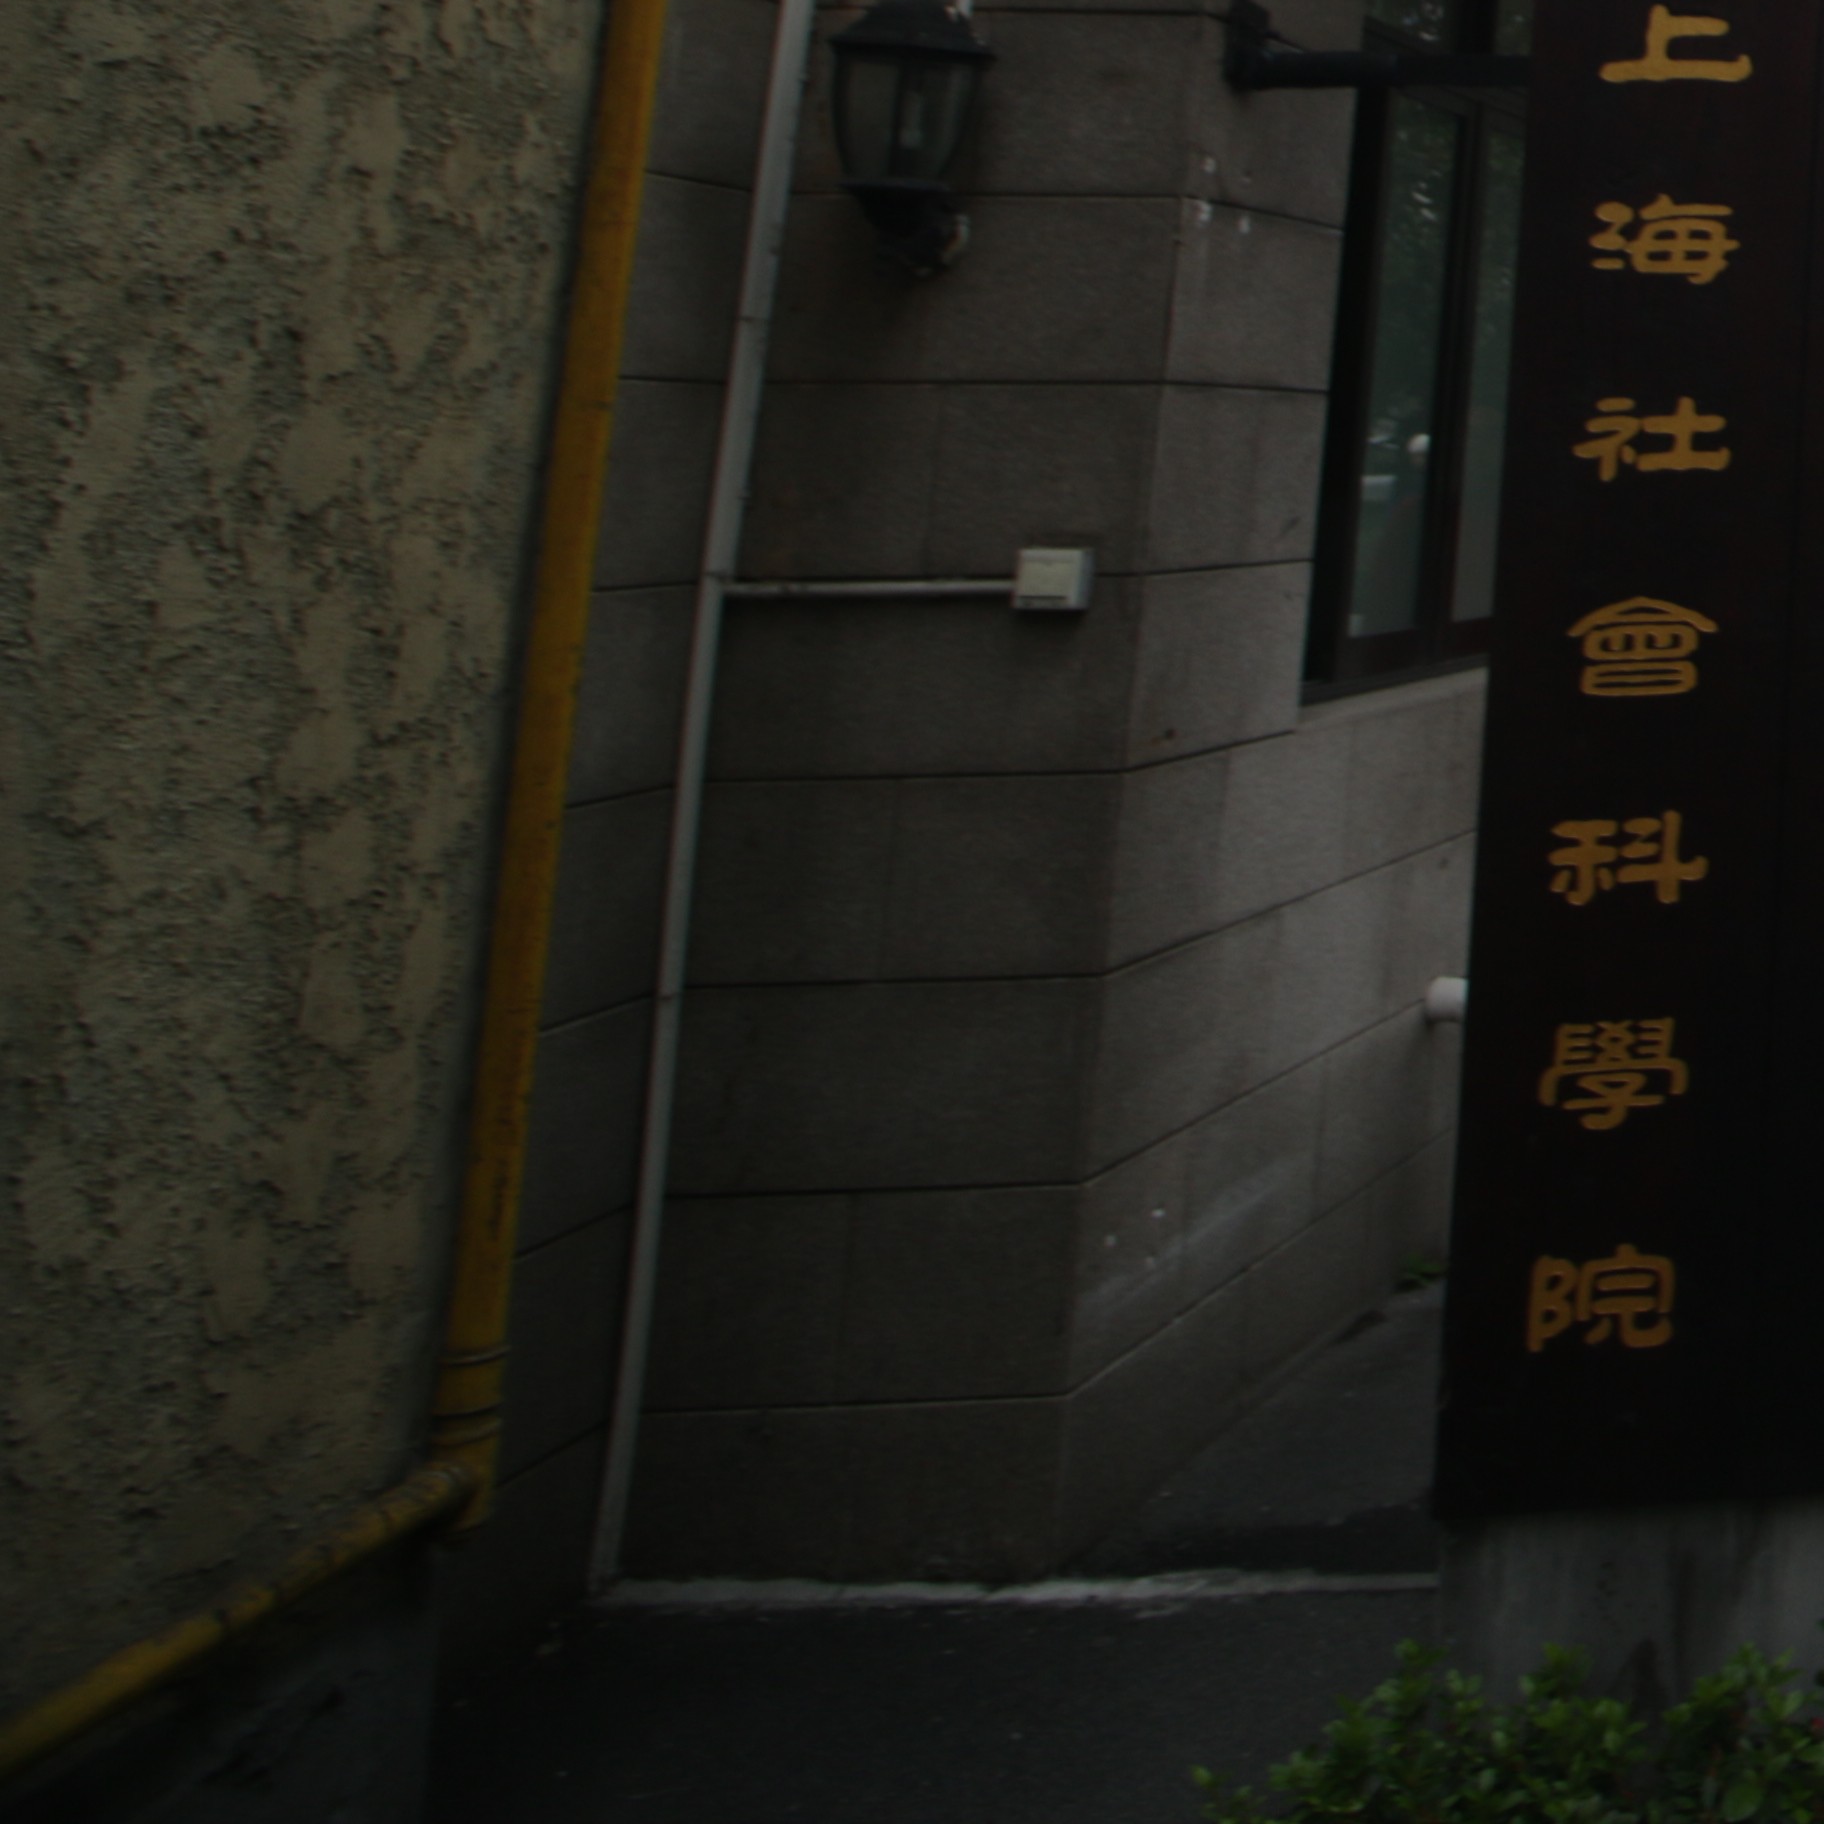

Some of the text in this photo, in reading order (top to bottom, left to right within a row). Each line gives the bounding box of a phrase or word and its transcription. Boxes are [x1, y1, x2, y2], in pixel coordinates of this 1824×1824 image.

[1525, 4, 1753, 1353] 上海社會科學院
